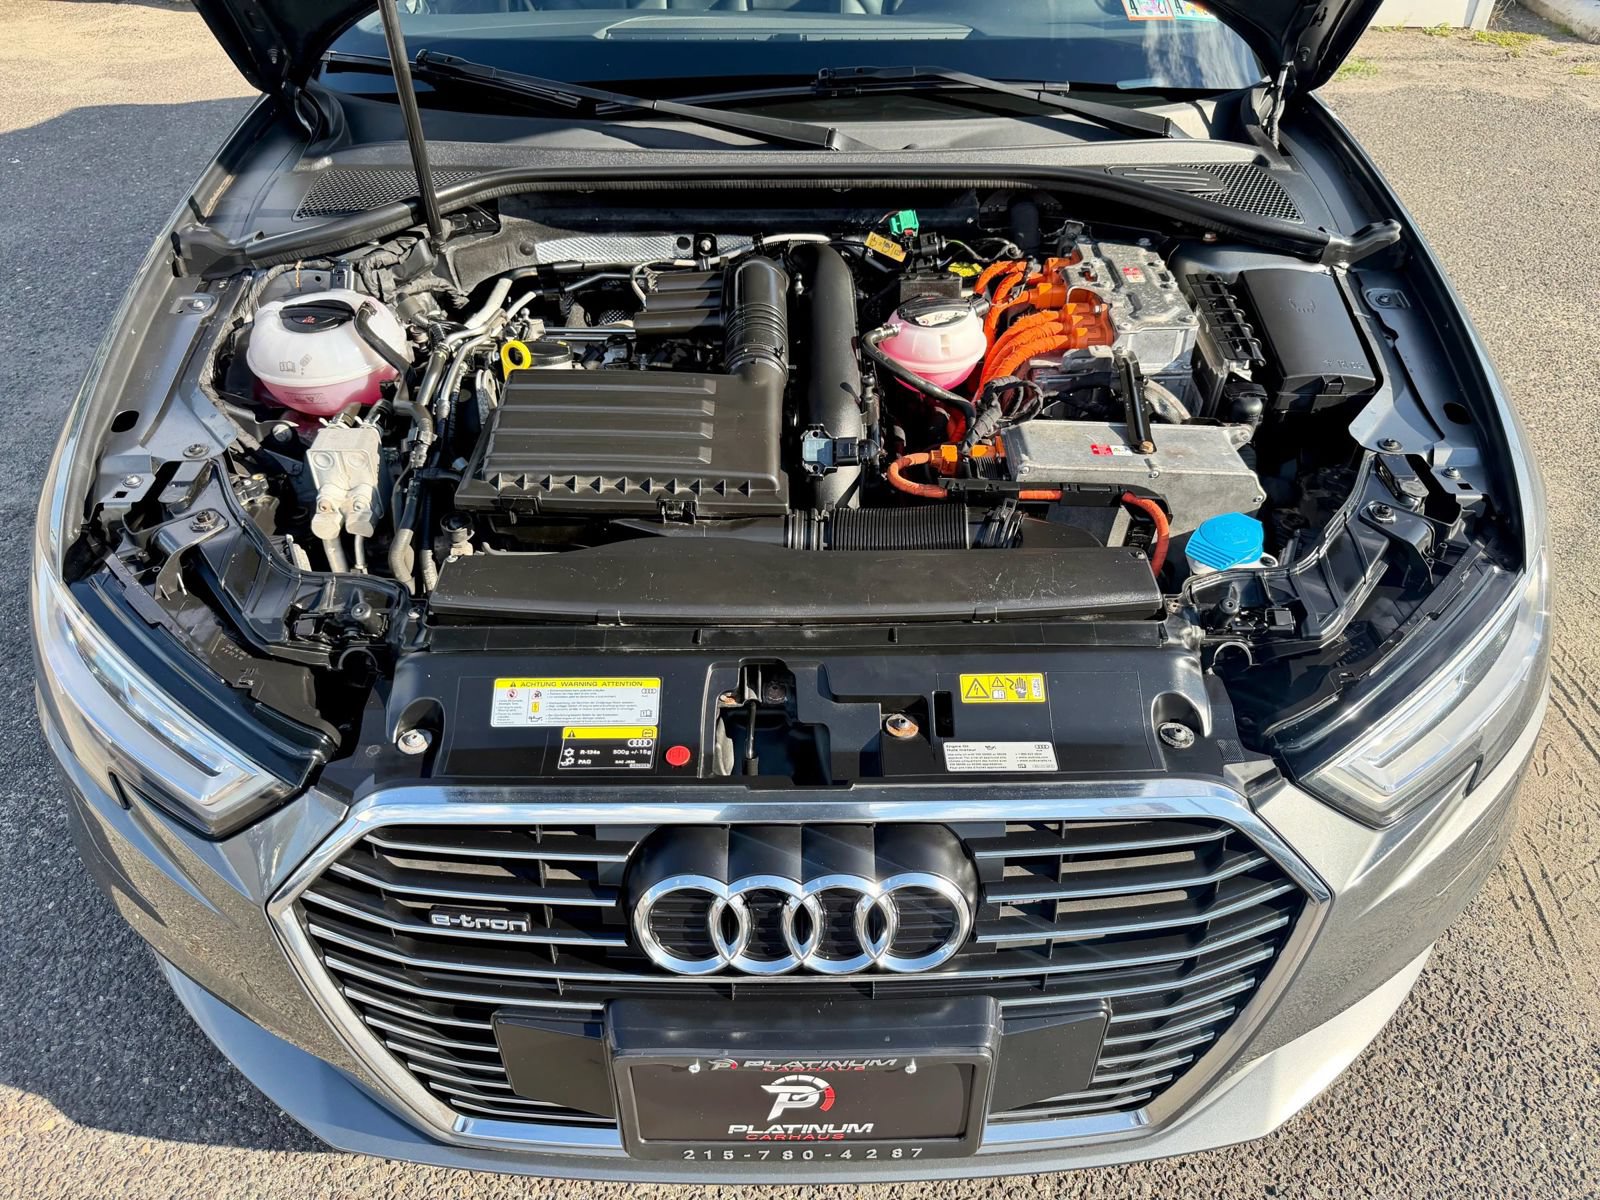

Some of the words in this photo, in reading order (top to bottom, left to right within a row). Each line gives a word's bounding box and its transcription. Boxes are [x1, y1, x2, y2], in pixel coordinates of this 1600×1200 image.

[431, 914, 527, 932] e-tron
[743, 1059, 897, 1068] PLATINUM
[728, 1123, 874, 1134] PLATINUM
[745, 1133, 846, 1141] CARHAUS
